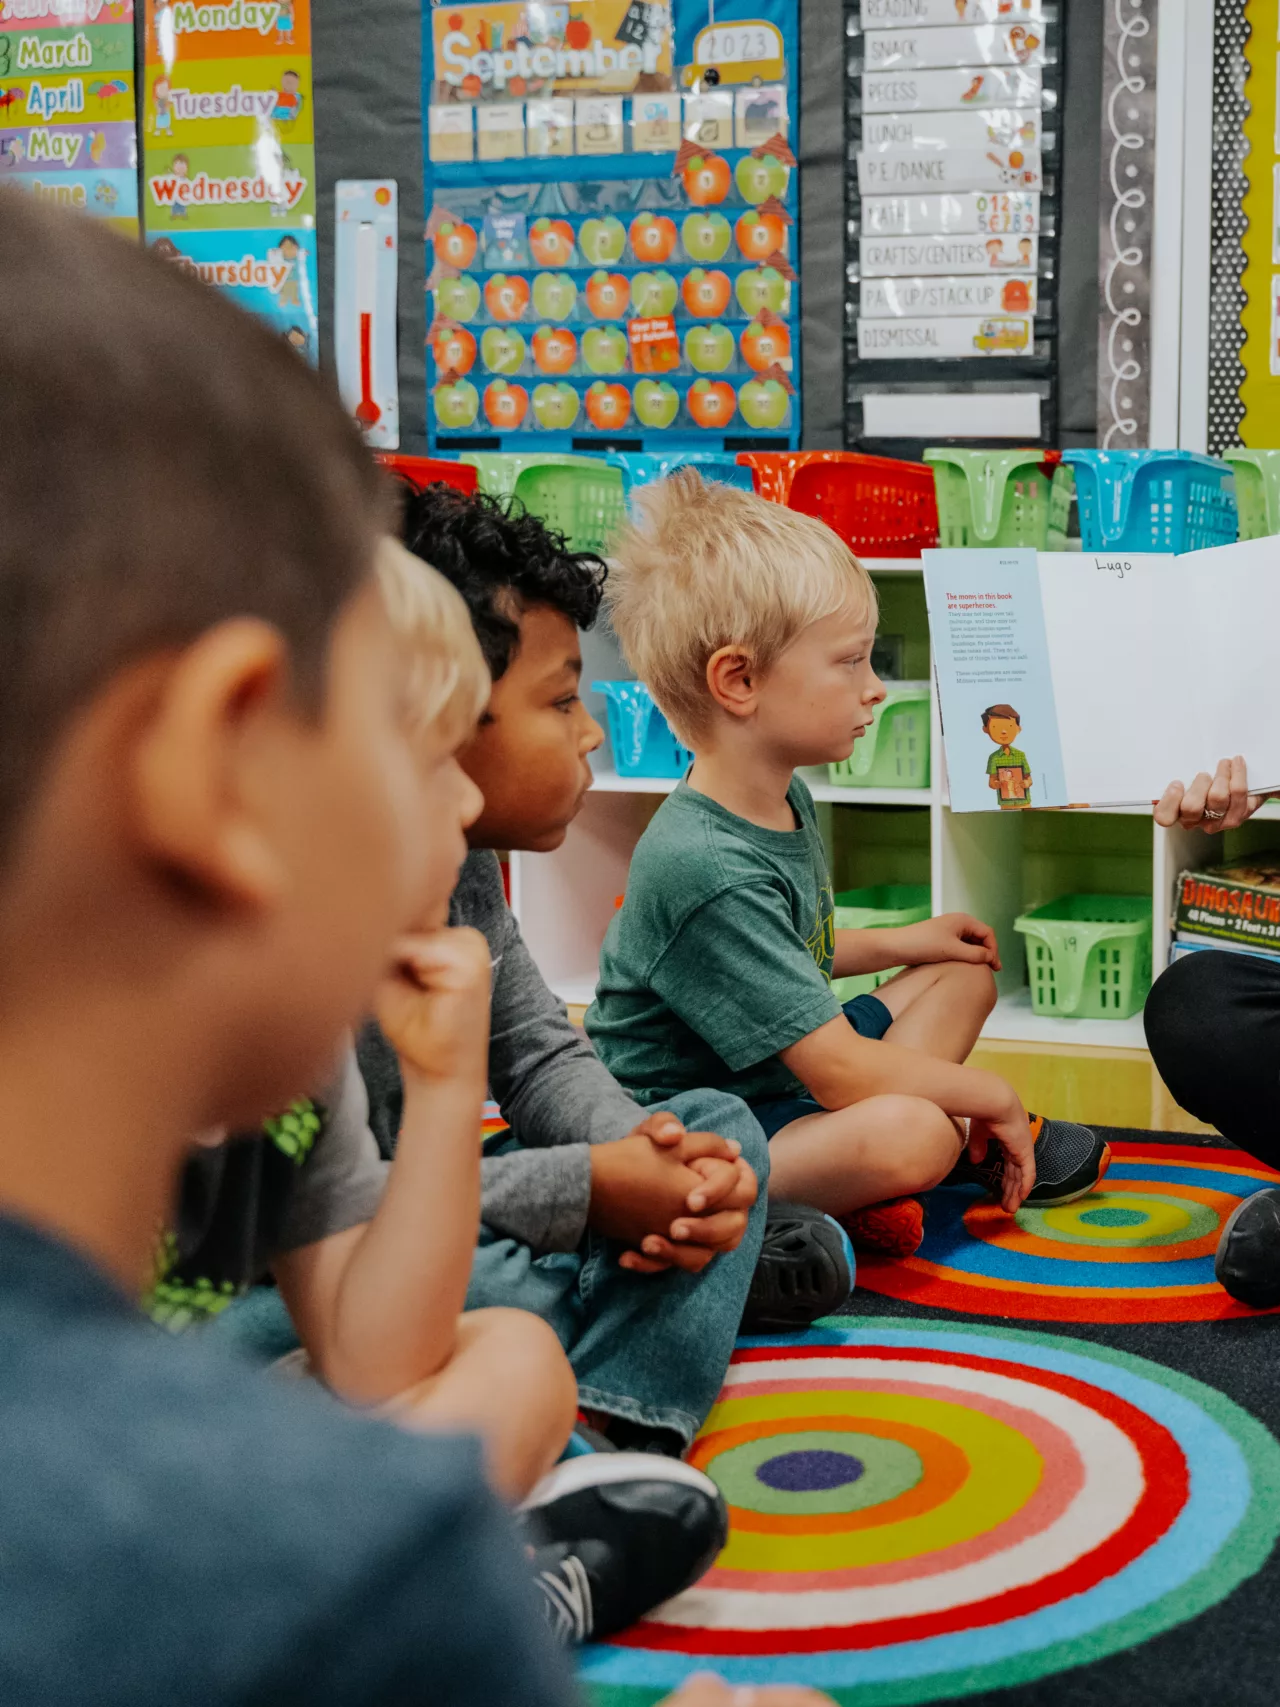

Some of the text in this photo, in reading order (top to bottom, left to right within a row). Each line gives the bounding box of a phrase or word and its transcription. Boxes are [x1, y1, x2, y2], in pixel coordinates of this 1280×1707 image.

[174, 0, 278, 31] Monday
[19, 35, 91, 66] March
[706, 33, 767, 60] 2023
[871, 40, 917, 60] SNACK
[443, 31, 662, 89] September
[28, 81, 84, 118] April
[868, 82, 918, 100] RECESS
[172, 87, 276, 118] Tuesday
[868, 124, 913, 145] LUNCH
[28, 130, 81, 165] May
[867, 243, 985, 266] CRAFTS/CENTERS
[977, 286, 995, 303] UP
[863, 329, 939, 348] DISMISSAL
[1094, 558, 1132, 579] Lugo
[946, 592, 957, 600] The
[978, 592, 984, 600] in
[985, 592, 996, 600] this
[997, 592, 1012, 600] book
[1235, 918, 1242, 930] 2
[1268, 924, 1275, 936] 3
